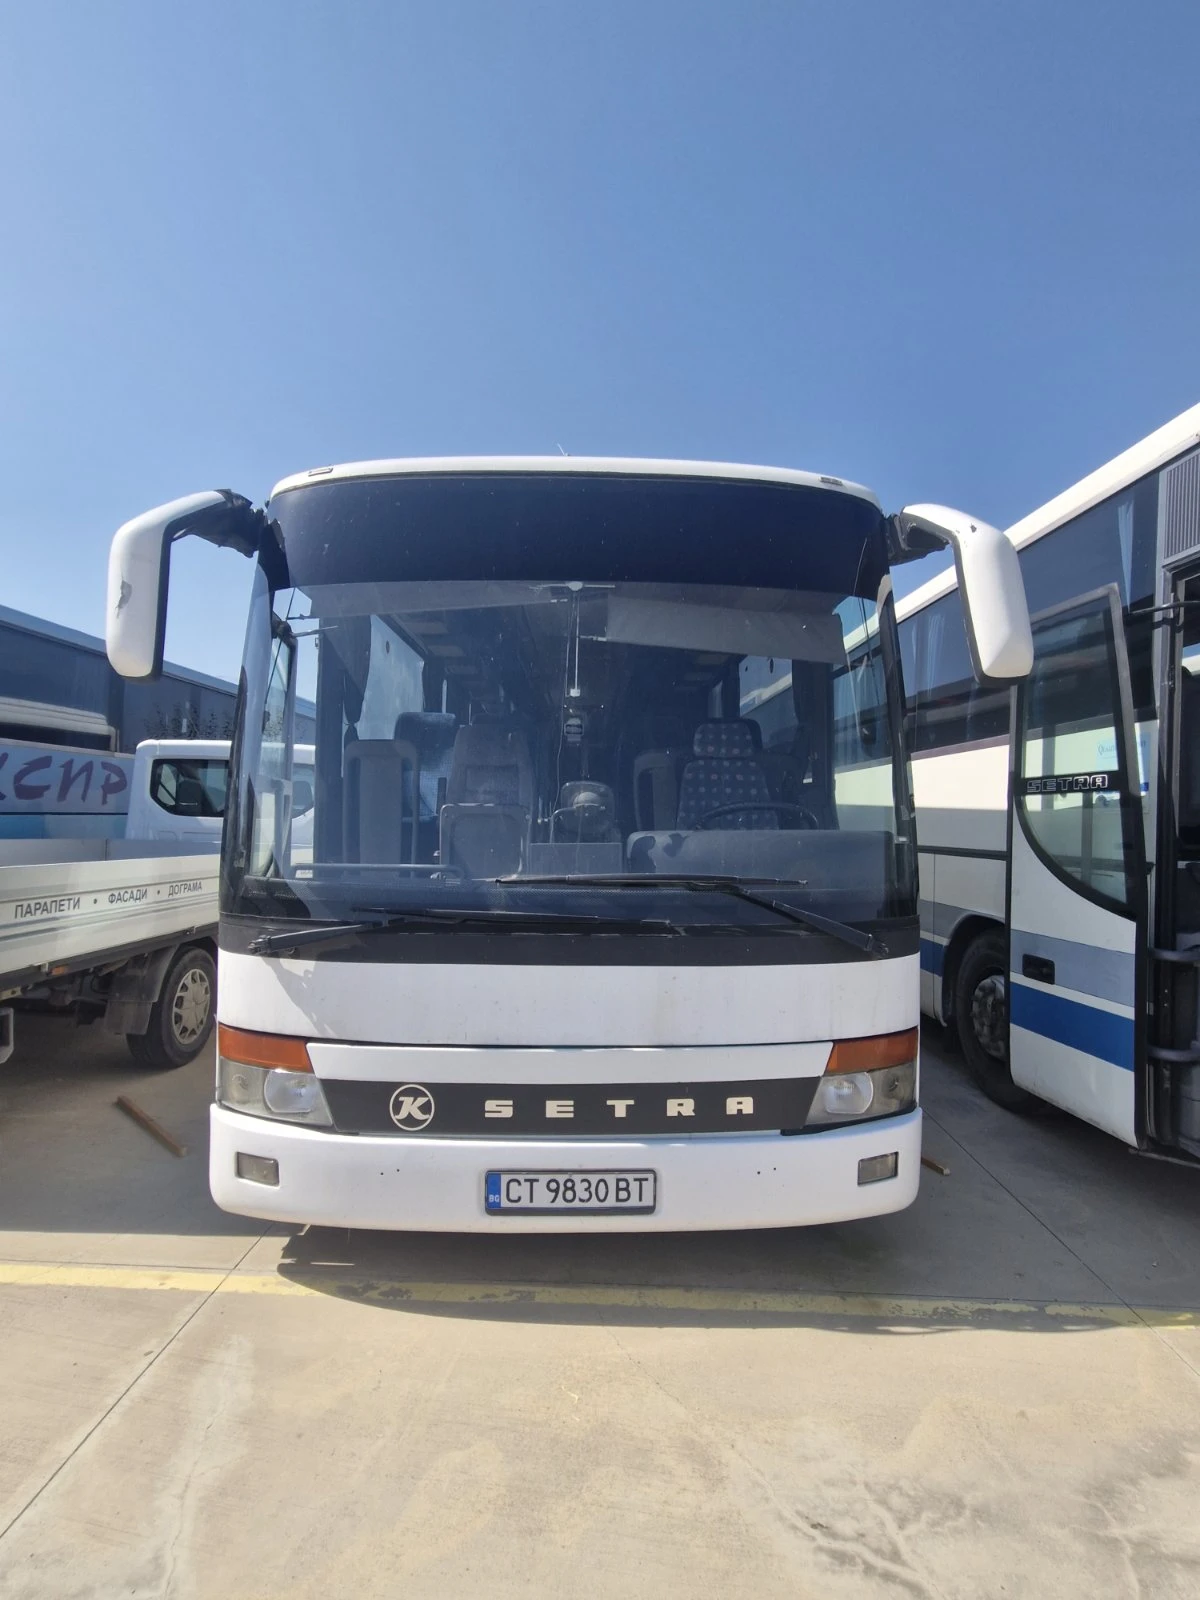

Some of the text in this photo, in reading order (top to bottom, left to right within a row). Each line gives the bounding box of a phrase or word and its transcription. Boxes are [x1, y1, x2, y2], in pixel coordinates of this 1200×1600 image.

[0, 752, 127, 805] СИР
[1027, 774, 1108, 792] SETRA
[14, 881, 203, 919] ПАРАПЕТИ ФАСАДИ ДОГРАМА
[484, 1097, 754, 1118] SETRA
[489, 1194, 500, 1203] BG
[546, 1178, 609, 1204] 9830
